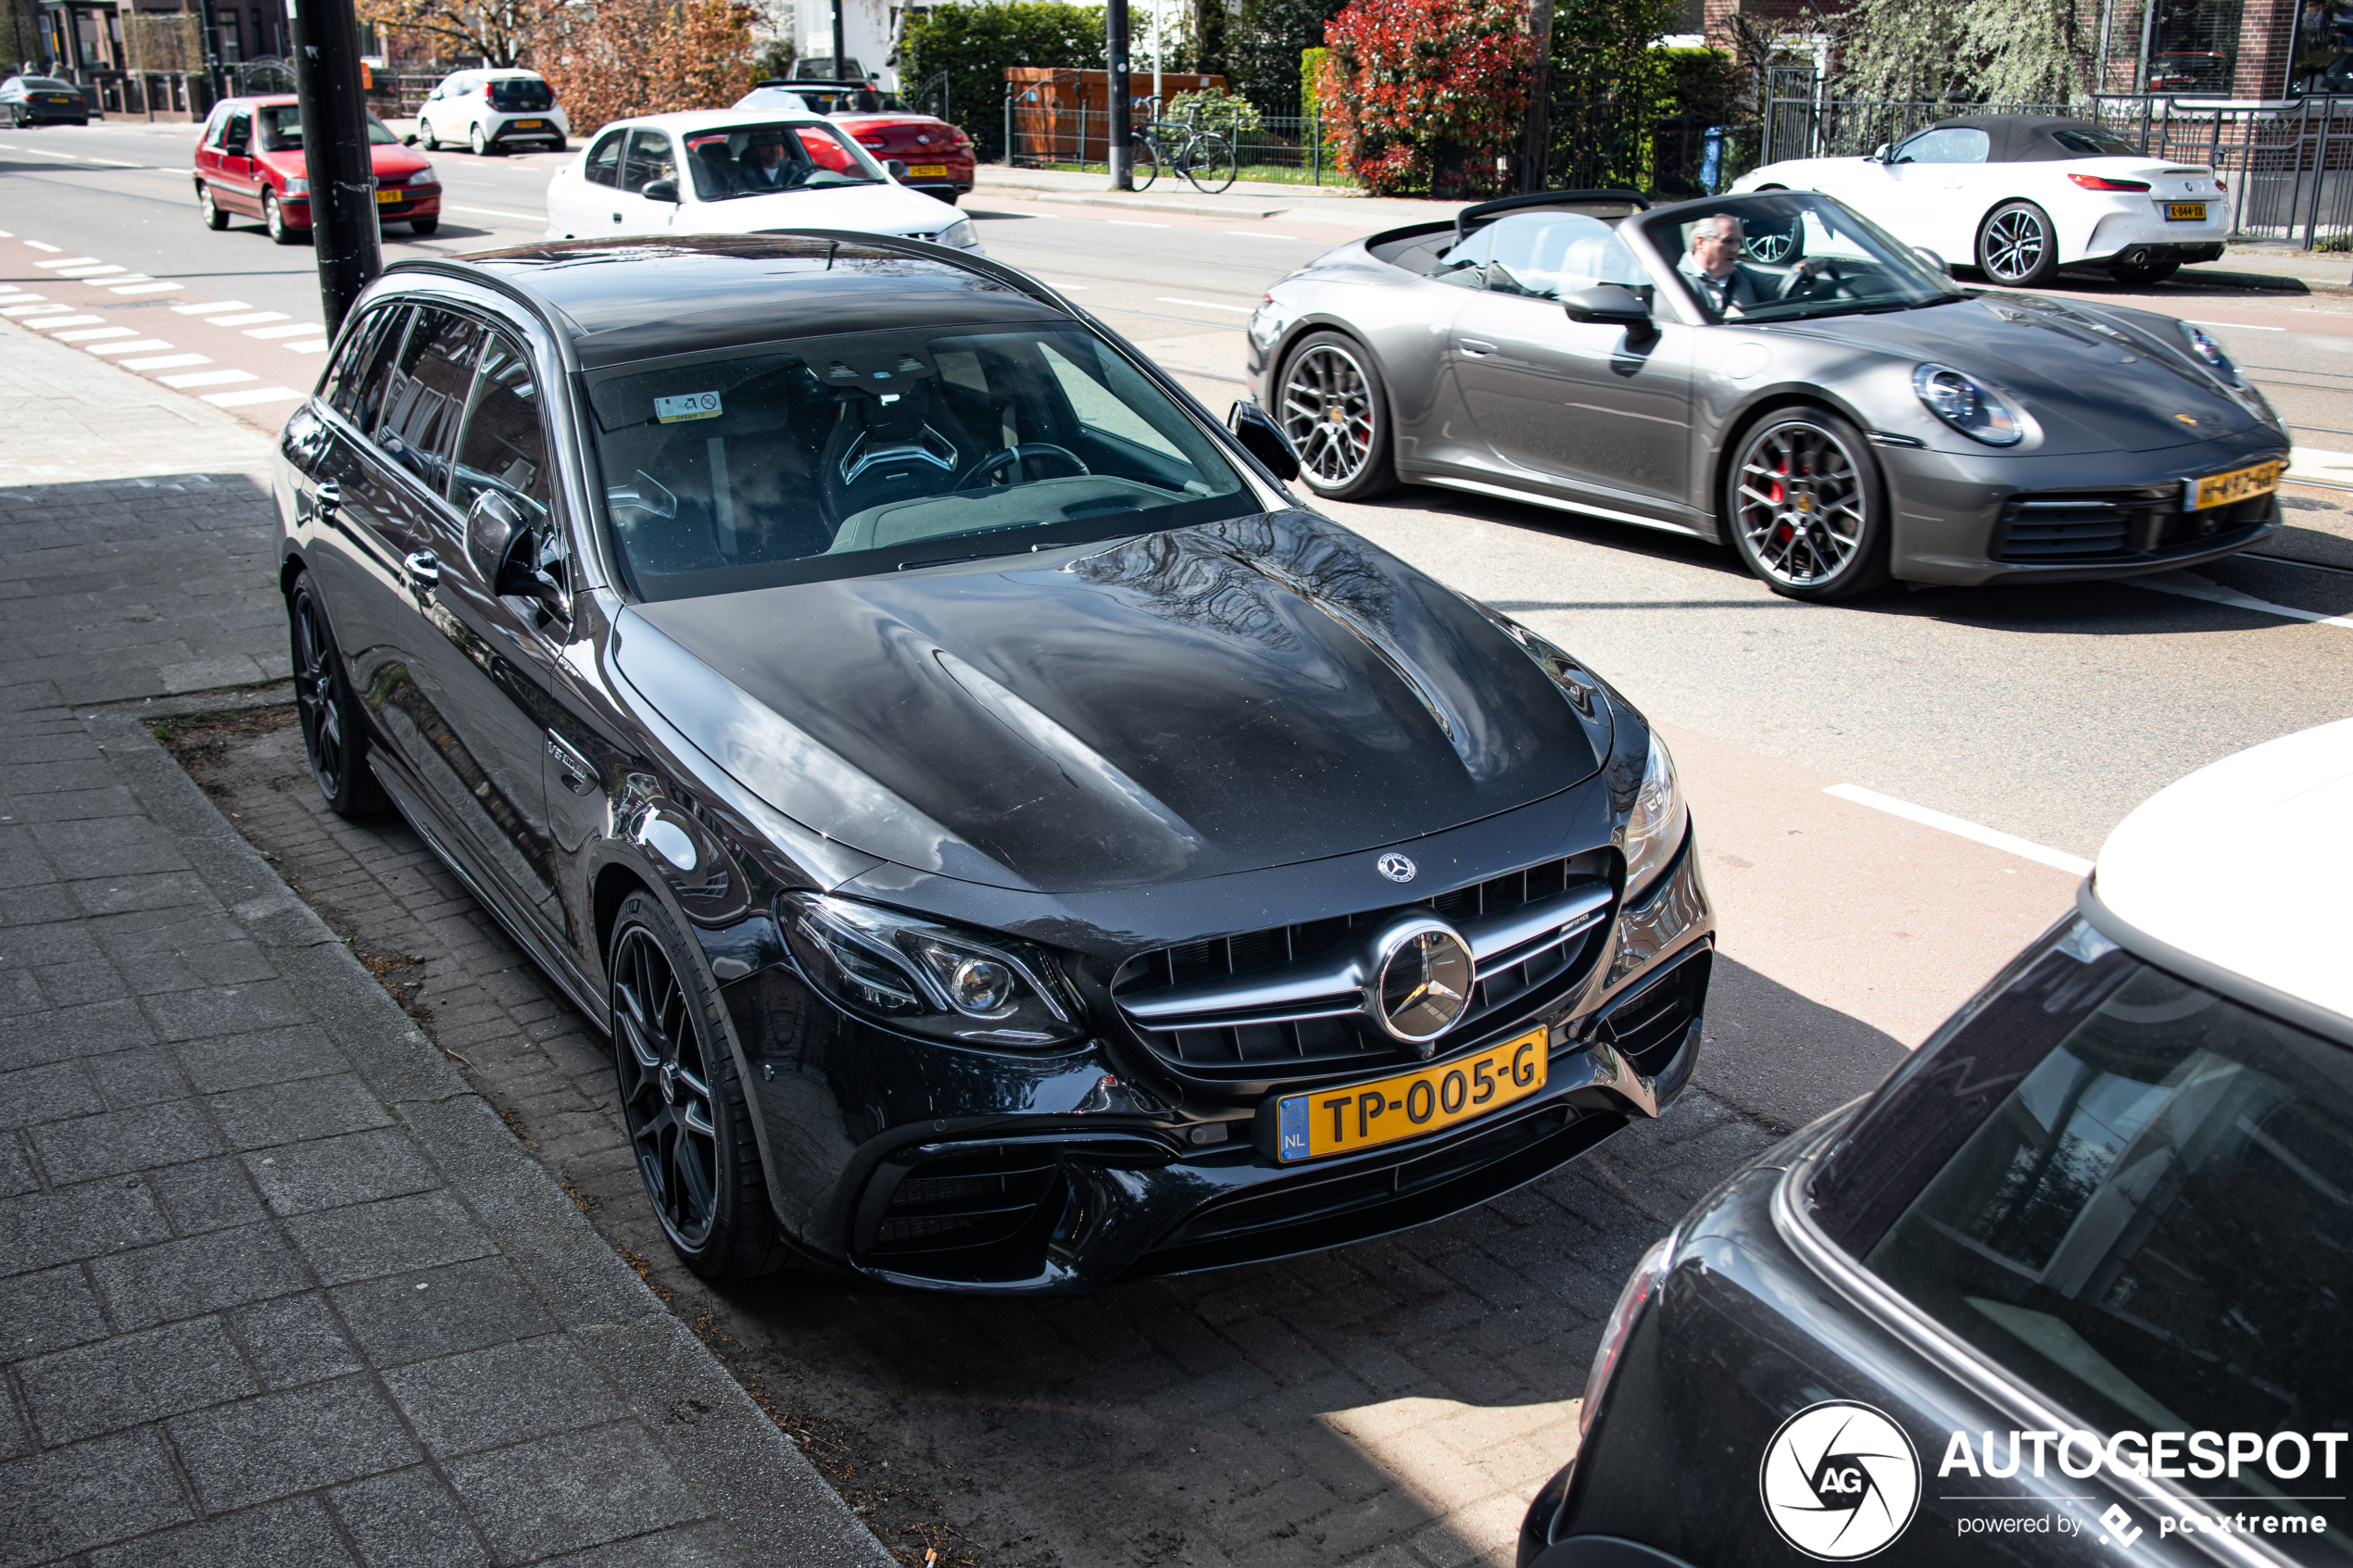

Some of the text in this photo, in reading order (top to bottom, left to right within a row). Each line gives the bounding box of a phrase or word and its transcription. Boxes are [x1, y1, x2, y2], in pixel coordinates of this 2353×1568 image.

[376, 190, 398, 202] S-PB
[2171, 206, 2204, 217] K-844-XR
[675, 413, 698, 421] AIRBAG
[1323, 1042, 1535, 1143] TP-005-G
[1284, 1133, 1306, 1148] NL
